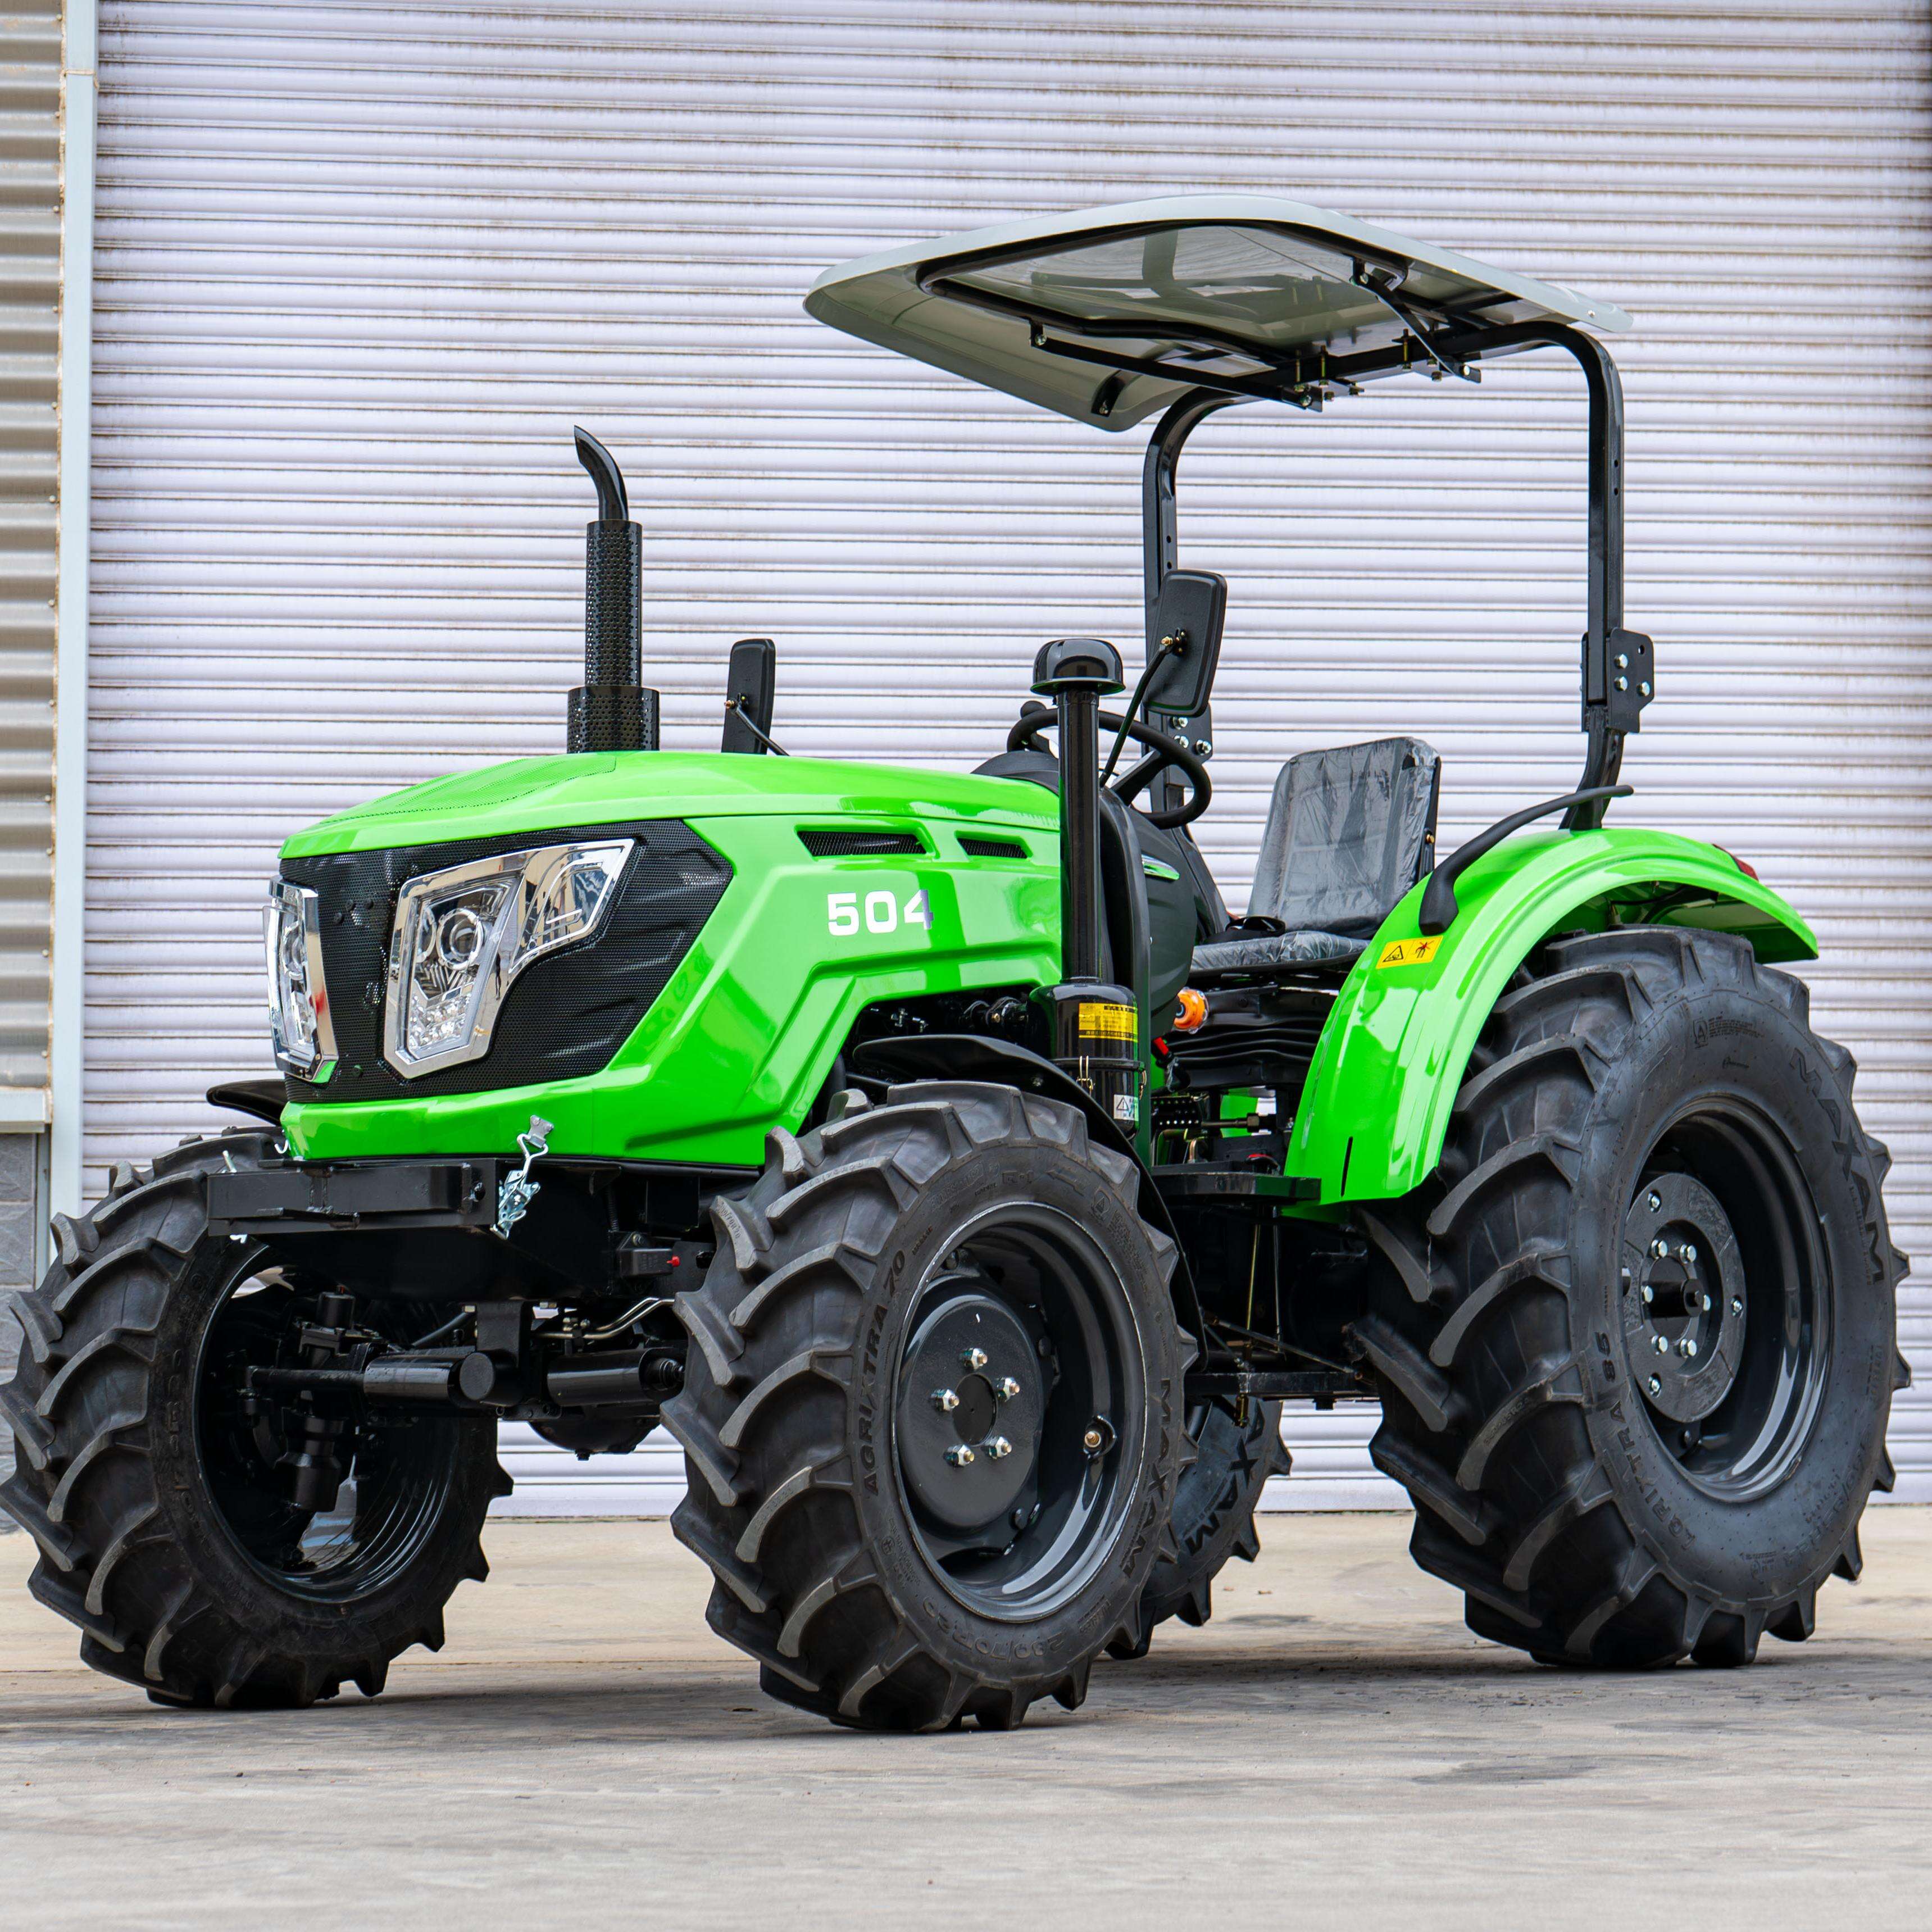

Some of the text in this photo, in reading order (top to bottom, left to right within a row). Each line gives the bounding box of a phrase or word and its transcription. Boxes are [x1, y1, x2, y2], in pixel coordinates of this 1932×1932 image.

[828, 889, 934, 936] 504
[1789, 1048, 1885, 1285] MAXAM
[858, 1304, 888, 1497] AGRIXTRA
[1122, 1379, 1171, 1576] MAXAM
[1184, 1398, 1266, 1556] AXAM
